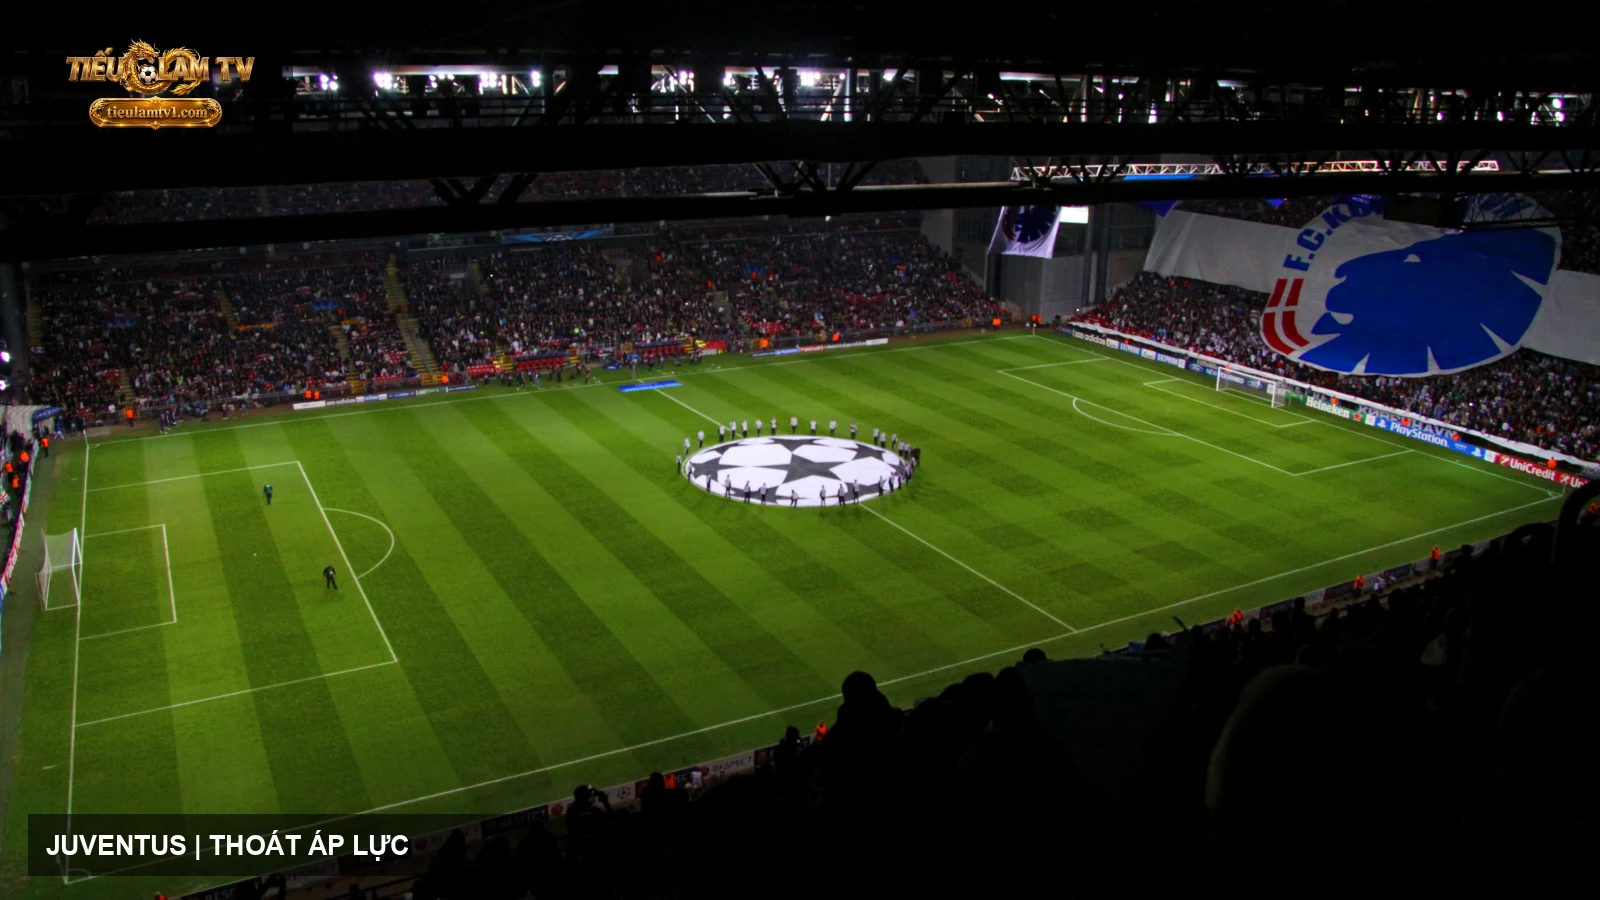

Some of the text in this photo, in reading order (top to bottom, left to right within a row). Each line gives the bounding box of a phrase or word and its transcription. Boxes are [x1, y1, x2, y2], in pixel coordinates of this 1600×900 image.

[1306, 396, 1351, 418] Heineken
[1390, 422, 1448, 447] PlayStation
[1509, 458, 1556, 481] UniCredit
